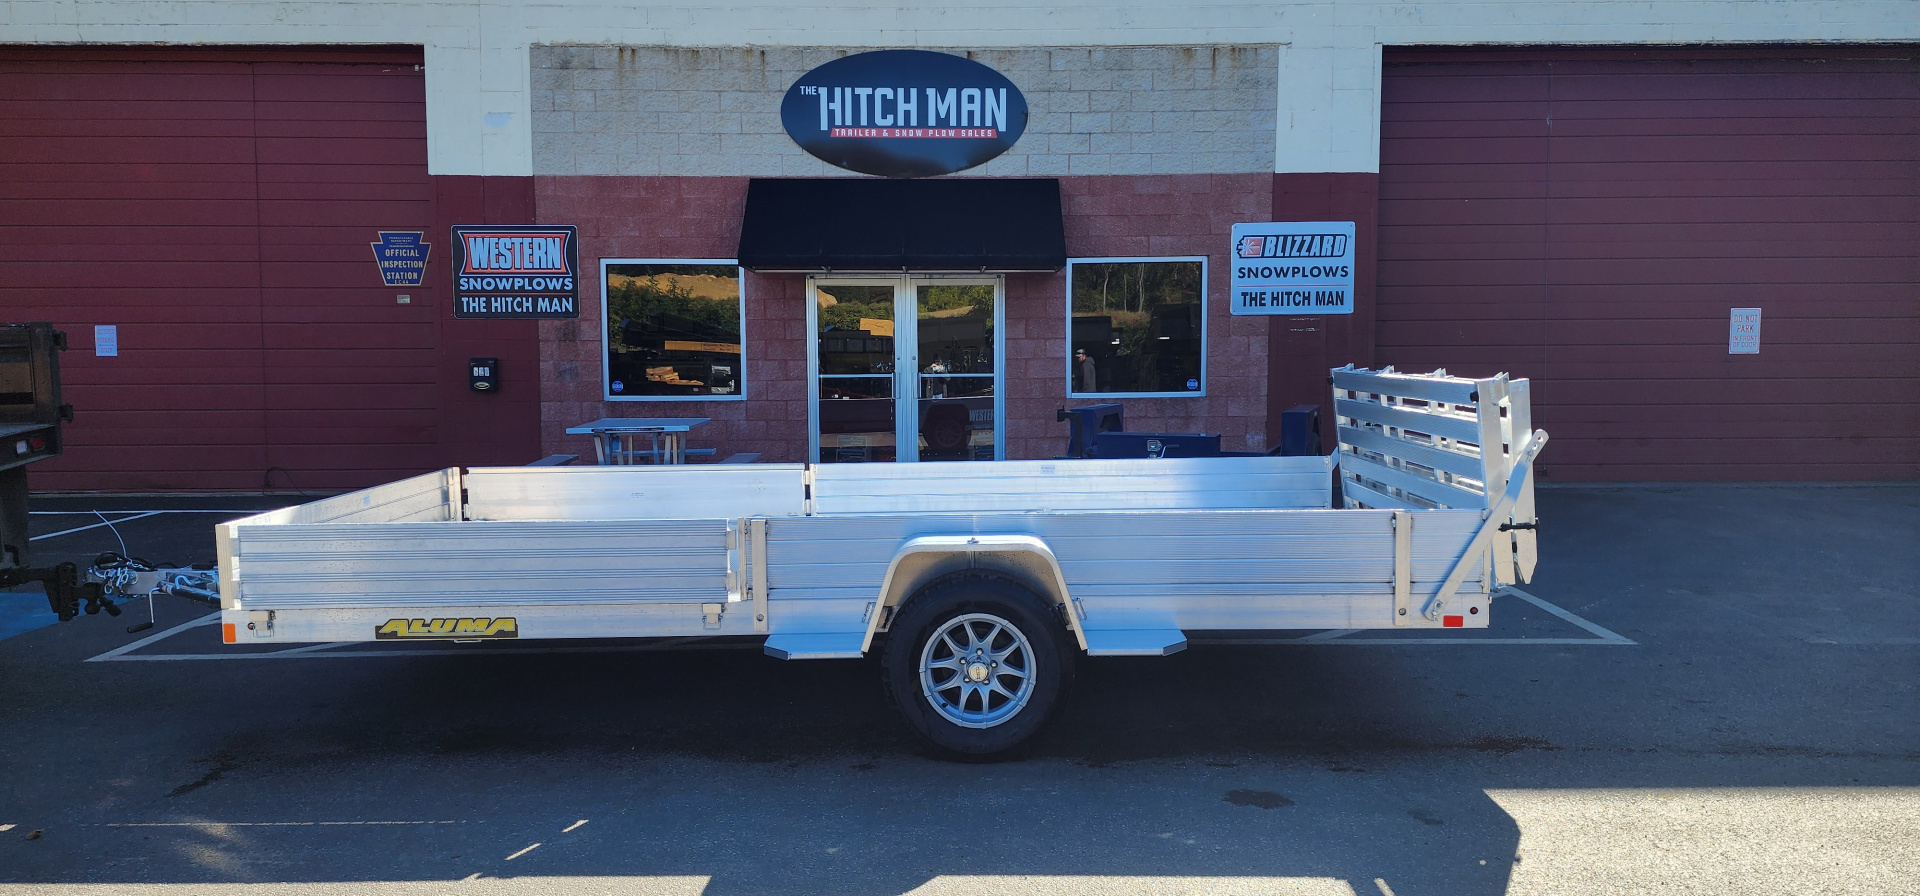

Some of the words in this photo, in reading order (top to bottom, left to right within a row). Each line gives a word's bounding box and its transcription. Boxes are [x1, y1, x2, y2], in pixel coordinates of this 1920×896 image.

[800, 85, 817, 96] THE
[818, 86, 917, 130] HITCH
[926, 87, 1007, 131] MAN
[835, 129, 876, 137] TRAILER
[882, 129, 889, 137] &
[895, 129, 923, 137] SNOW
[928, 129, 955, 137] PLOW
[961, 129, 992, 137] SALES
[385, 249, 419, 257] OFFICIAL
[1264, 235, 1346, 257] BLIZZARD
[468, 237, 560, 270] WESTERN
[1237, 266, 1348, 279] SNOWPLOWS
[459, 277, 573, 291] SNOWPLOWS
[461, 297, 486, 312] THE
[491, 297, 532, 312] HITCH
[537, 297, 573, 312] MAN
[1241, 291, 1266, 307] THE
[1271, 291, 1311, 307] HITCH
[1315, 291, 1344, 306] MAN
[1734, 314, 1743, 322] DO
[1745, 314, 1758, 322] NOT
[1737, 324, 1754, 333] PARK
[378, 618, 516, 636] ALUMA
